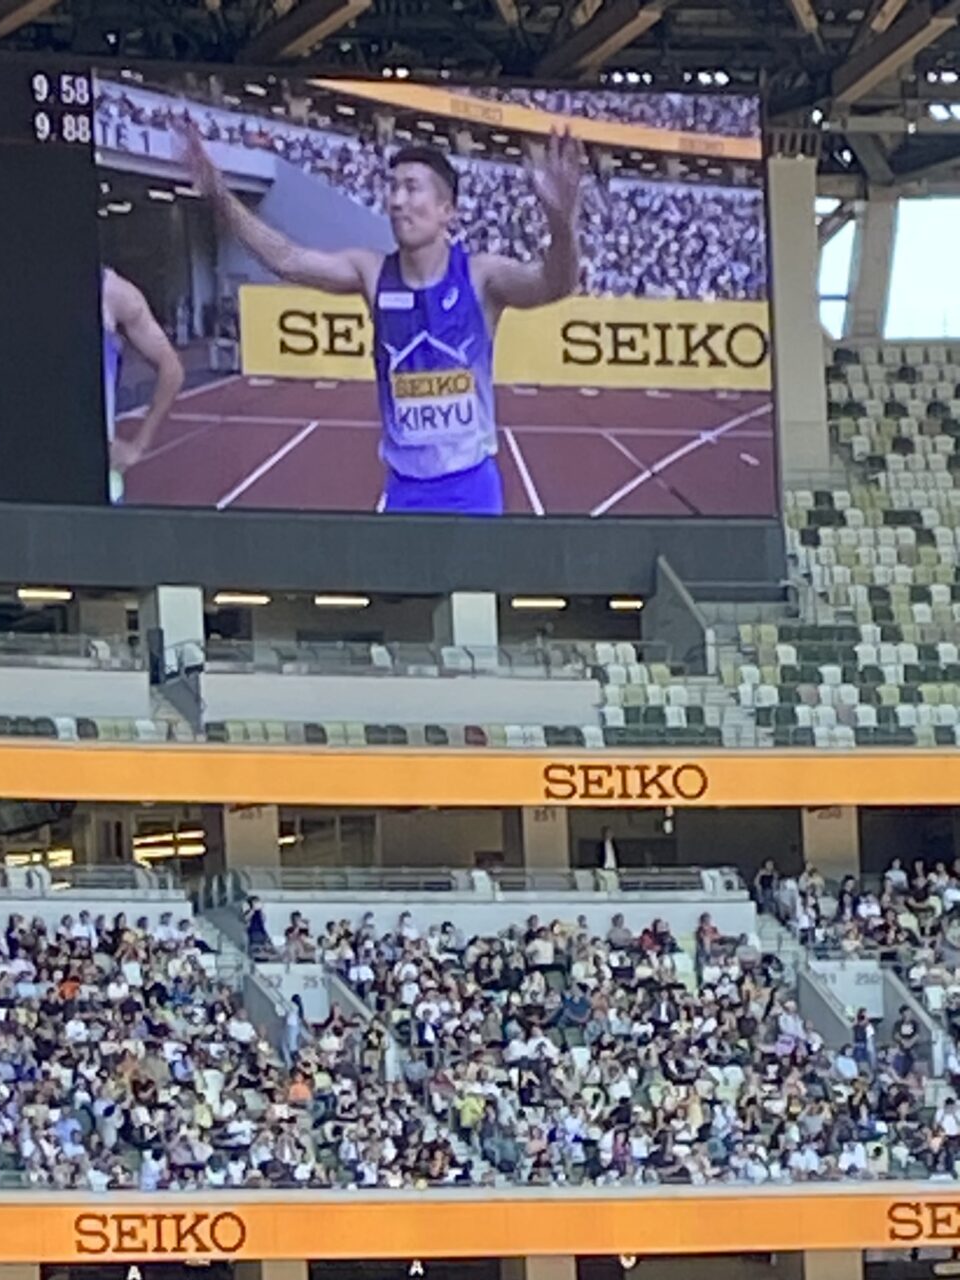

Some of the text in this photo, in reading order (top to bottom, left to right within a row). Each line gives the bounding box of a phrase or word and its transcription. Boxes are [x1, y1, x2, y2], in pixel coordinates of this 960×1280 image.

[561, 320, 769, 368] SEIKO
[395, 374, 470, 399] SEIKO
[396, 400, 472, 431] KIRYU
[543, 763, 708, 800] SEIKO
[75, 1212, 246, 1254] SEIKO
[887, 1202, 960, 1240] SE
